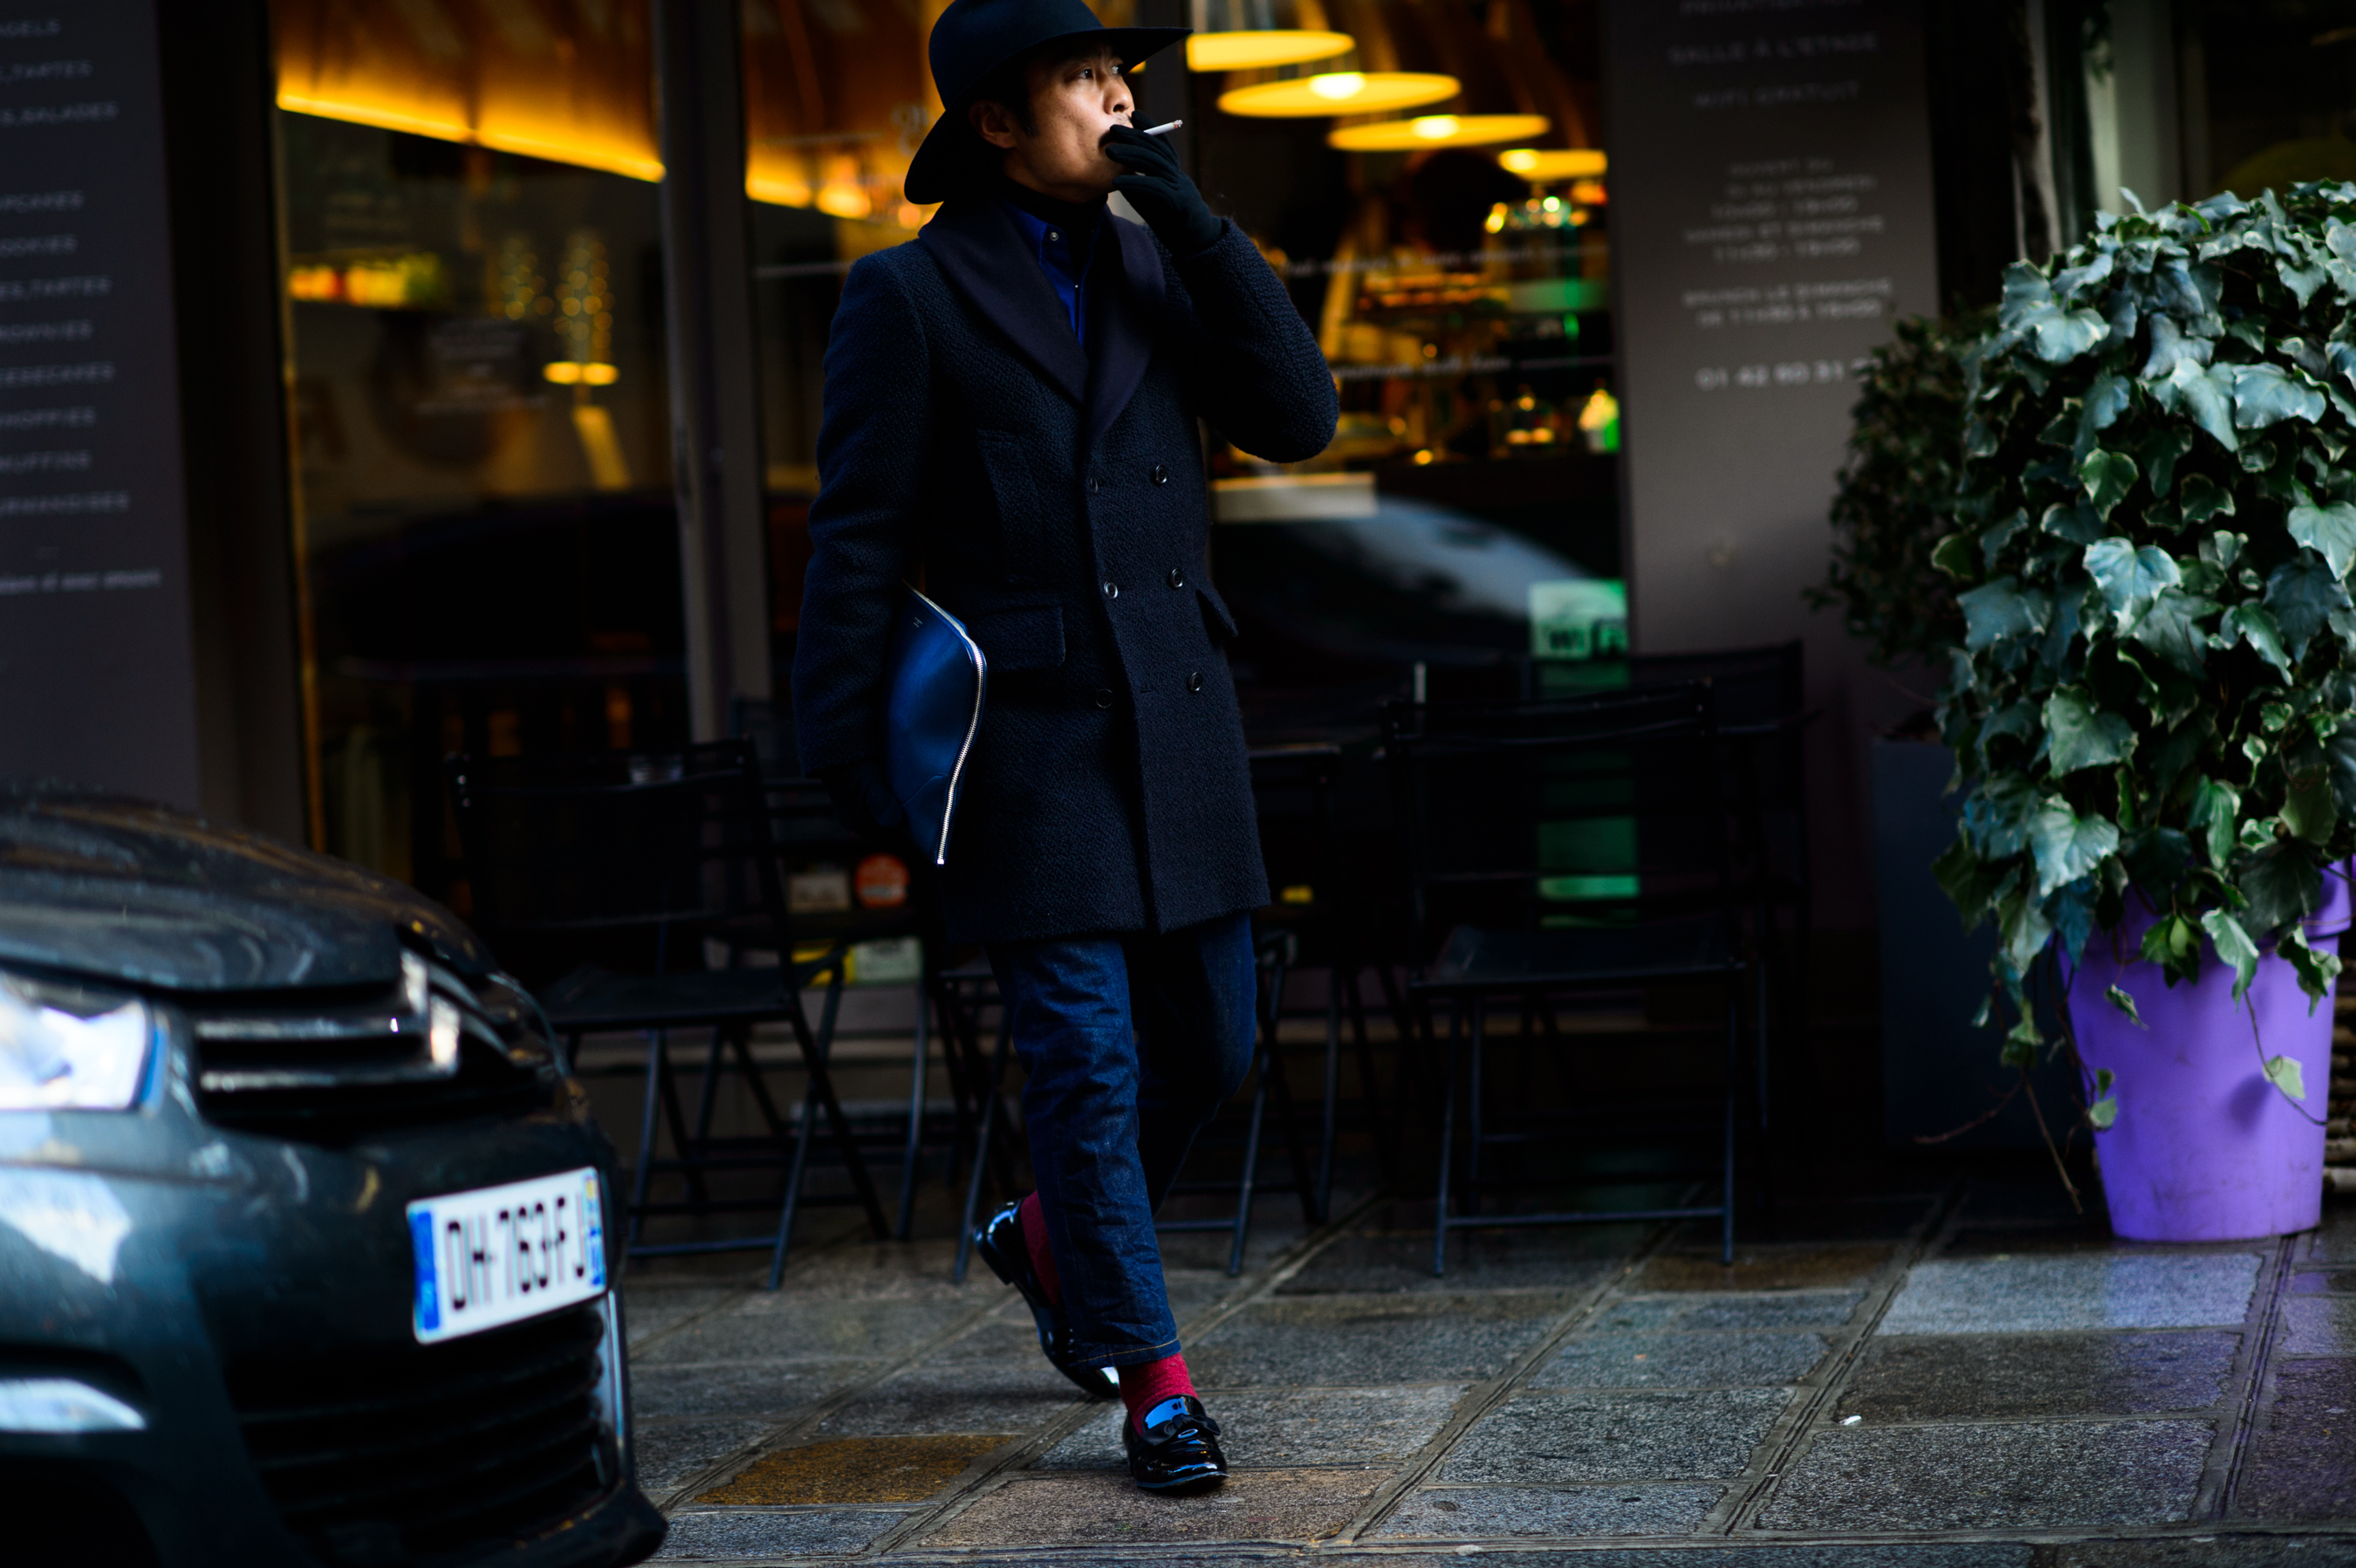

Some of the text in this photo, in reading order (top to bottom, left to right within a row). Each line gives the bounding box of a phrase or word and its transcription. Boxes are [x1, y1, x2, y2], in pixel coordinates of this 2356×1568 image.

[0, 190, 85, 214] PCAKES
[1793, 278, 1892, 301] DIMANCHE
[1695, 366, 1728, 391] 01
[1734, 364, 1769, 388] 42
